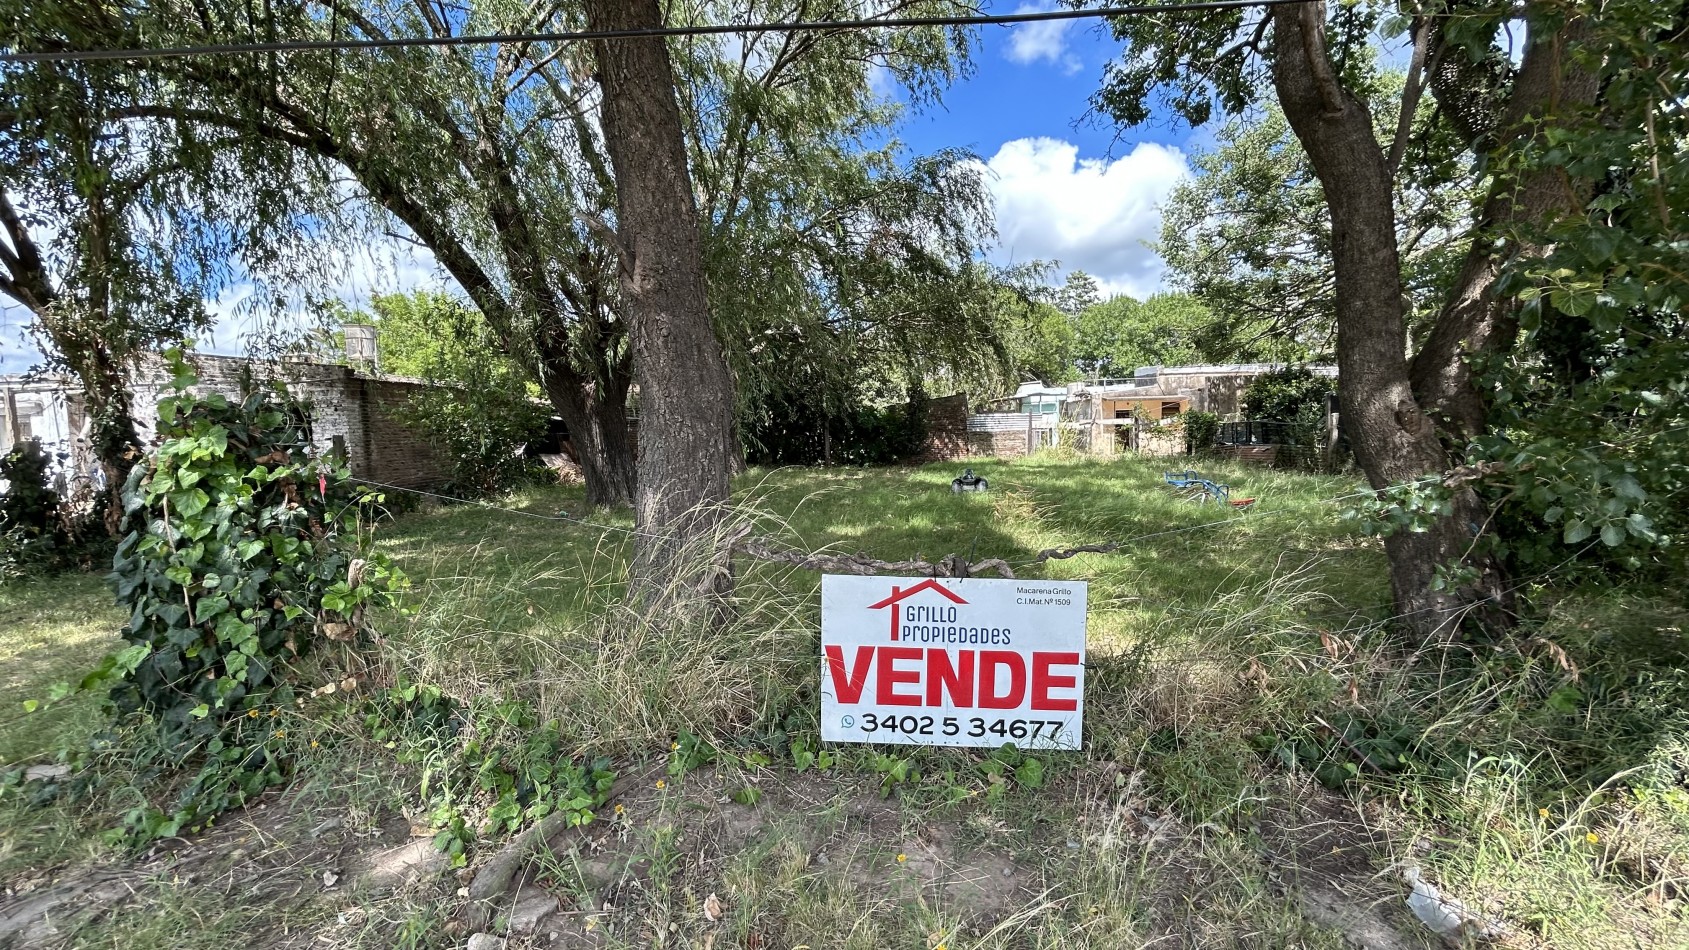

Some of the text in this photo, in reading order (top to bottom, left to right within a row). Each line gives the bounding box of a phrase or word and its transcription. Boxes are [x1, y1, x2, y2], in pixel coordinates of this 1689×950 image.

[1054, 598, 1071, 606] 1509
[824, 645, 1080, 711] VENDE
[860, 713, 1063, 740] 3402 5 34677
